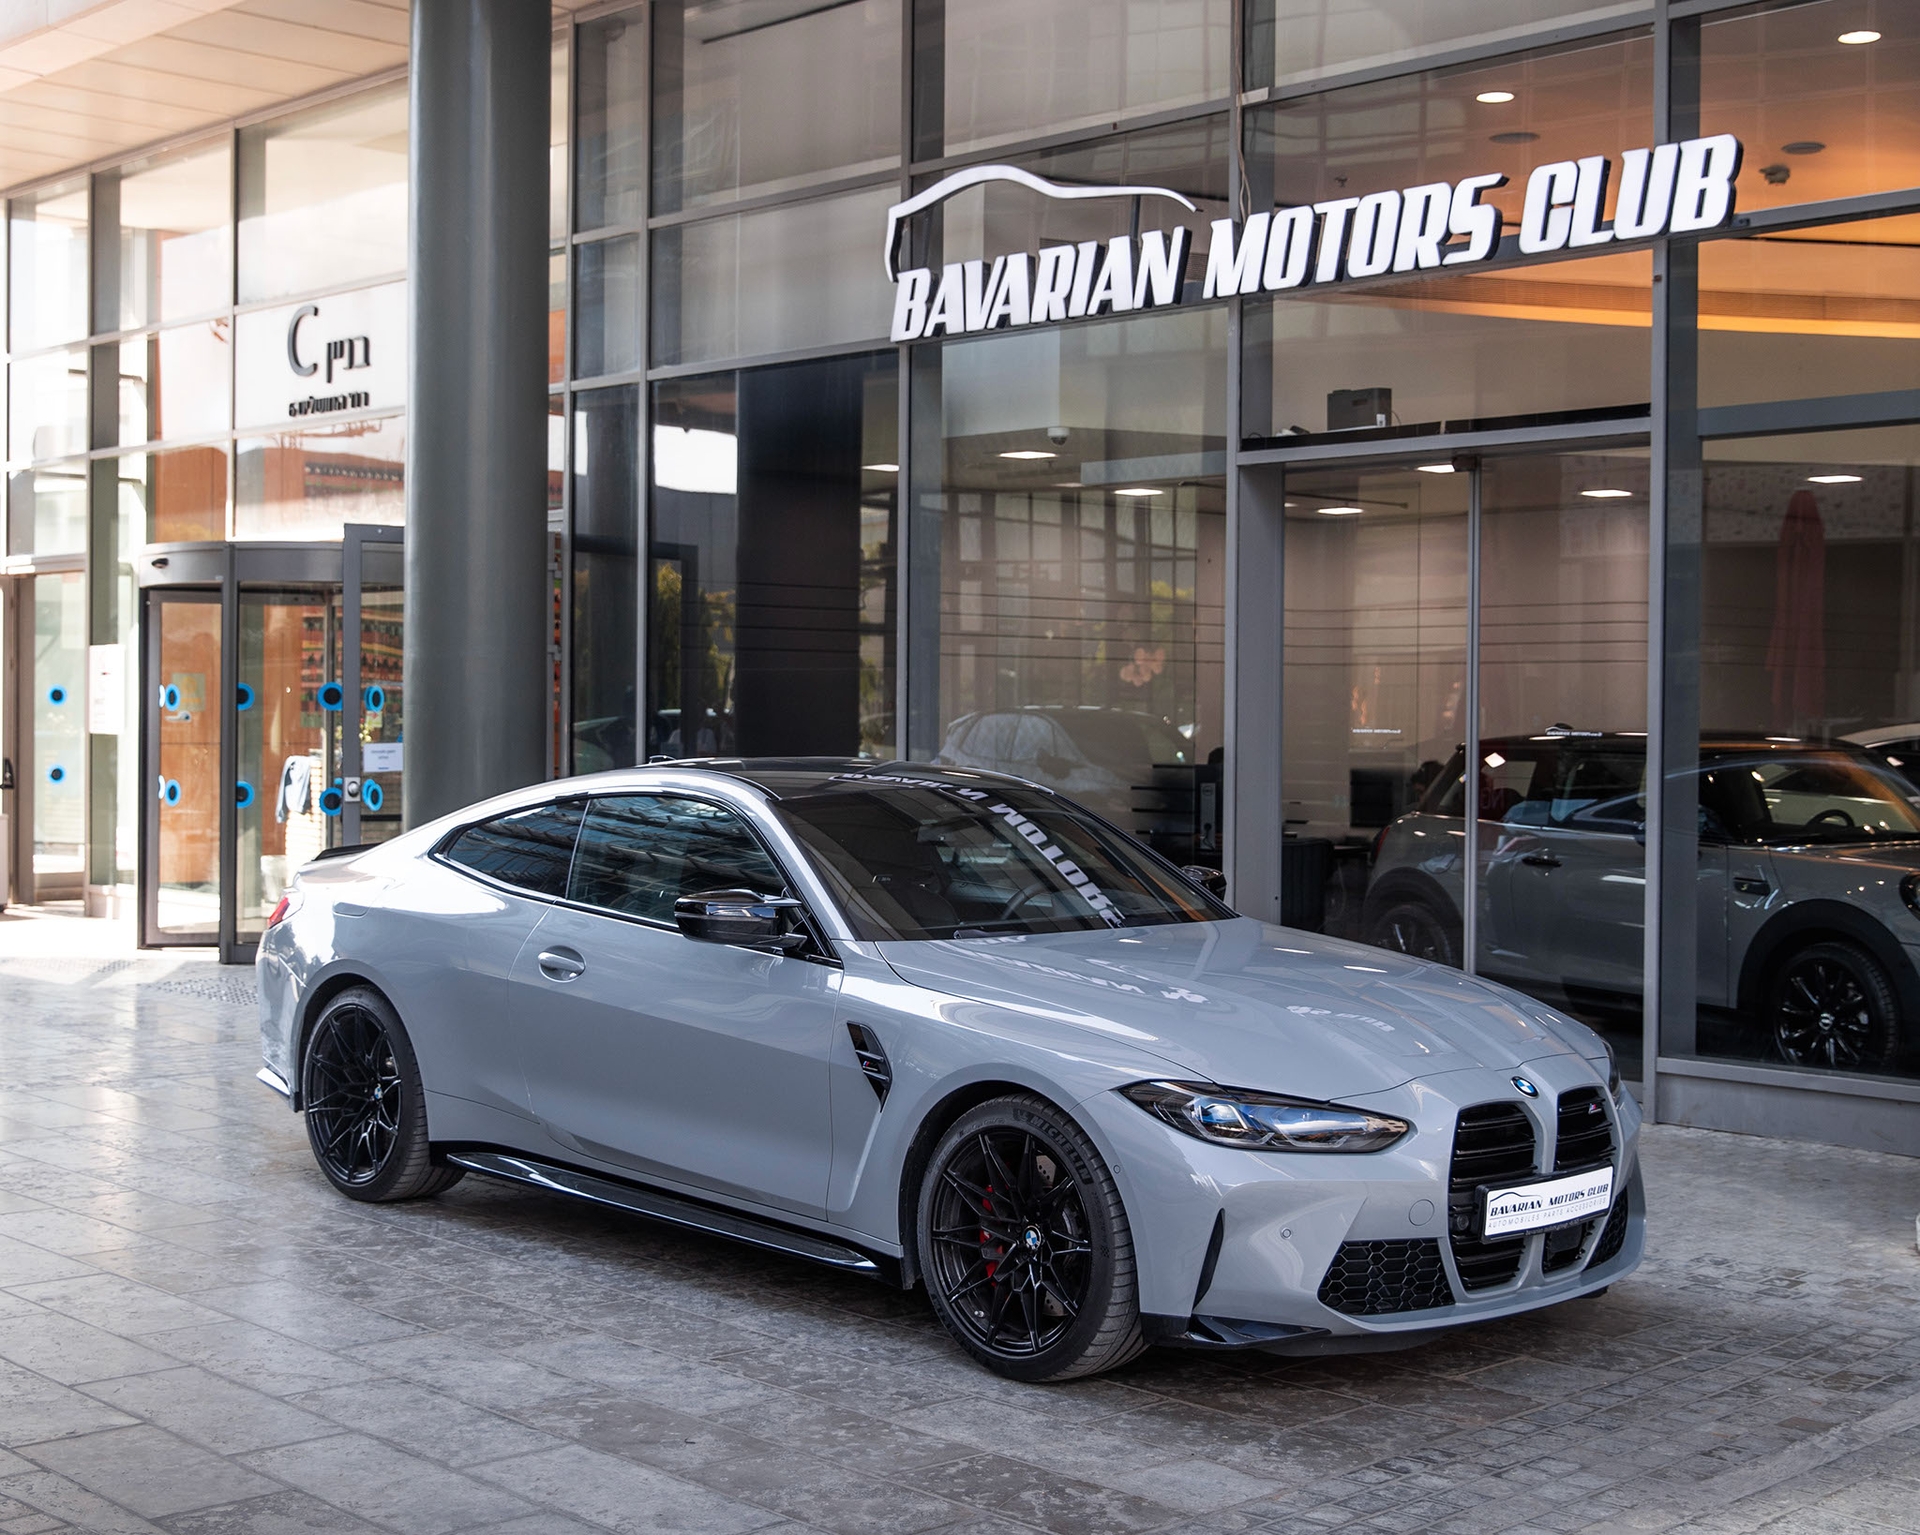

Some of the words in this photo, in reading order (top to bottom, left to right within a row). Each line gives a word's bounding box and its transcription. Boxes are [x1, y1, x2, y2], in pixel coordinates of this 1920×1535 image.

[890, 226, 1190, 342] BAVARIAN
[1202, 172, 1508, 299] MOTORS
[1519, 133, 1741, 254] CLUB
[287, 305, 318, 377] C
[1029, 1115, 1092, 1184] MICHELIN
[1488, 1213, 1540, 1228] AUTOMOBILES
[1543, 1208, 1564, 1219] PARTS
[1566, 1197, 1607, 1214] ACCESSORIES
[1490, 1199, 1542, 1217] BAVARIAN
[1549, 1189, 1585, 1206] MOTORS
[1587, 1183, 1609, 1197] CLUB
